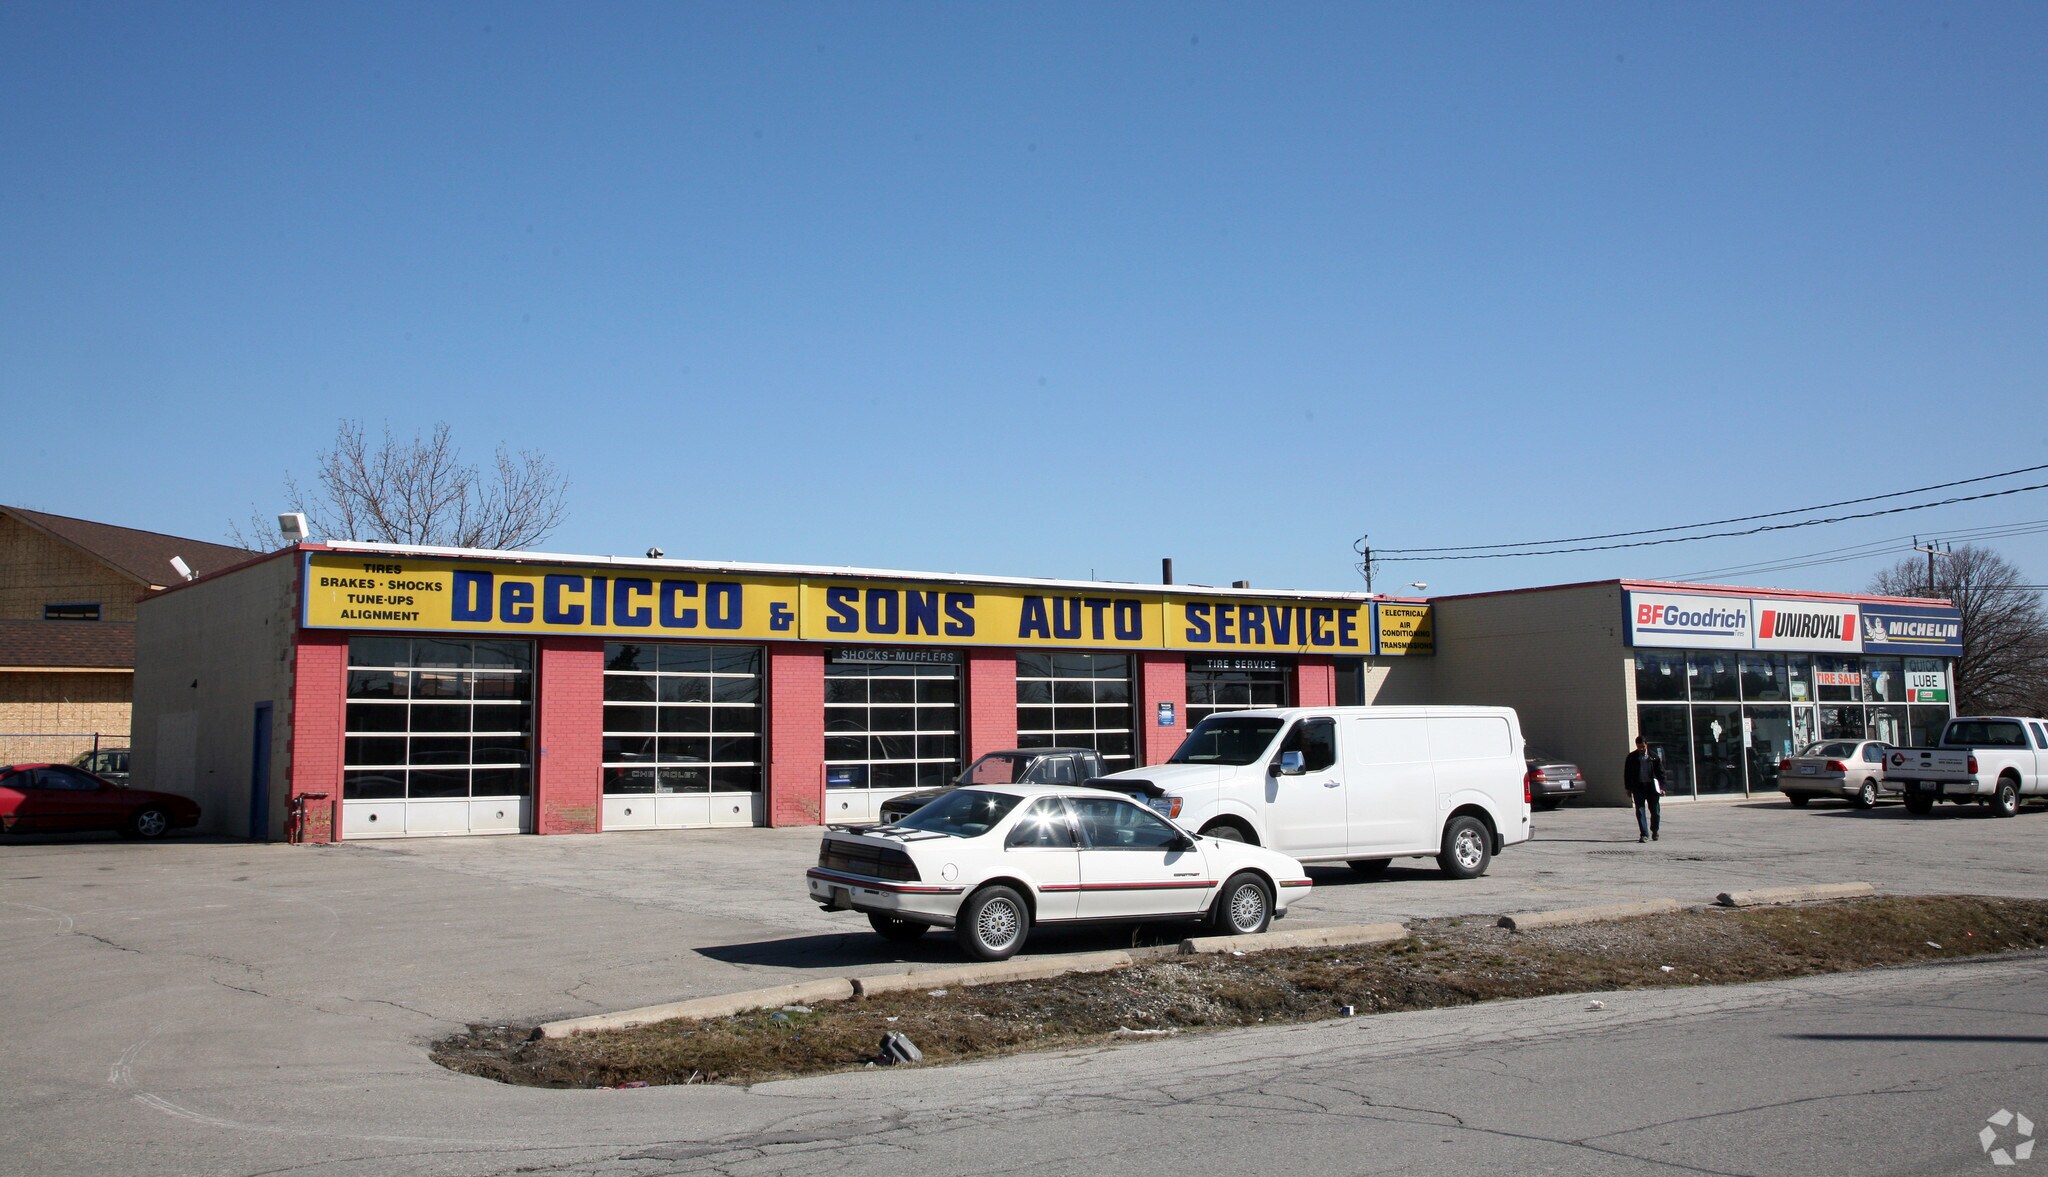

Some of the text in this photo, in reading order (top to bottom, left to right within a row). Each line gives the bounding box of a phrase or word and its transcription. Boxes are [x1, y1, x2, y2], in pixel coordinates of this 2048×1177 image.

[363, 563, 402, 575] TIRES
[320, 577, 443, 592] BRAKES SHOCKS
[347, 594, 414, 606] TUNE-UPS
[451, 569, 1359, 647] DeCICCO & SONS AUTO SERVICE
[340, 609, 420, 621] ALIGNMENT
[1637, 604, 1746, 628] BFGoodrich
[1774, 612, 1842, 639] UNIROYAL
[1889, 621, 1958, 638] MICHELIN
[1381, 629, 1430, 637] CONDITIONING
[1380, 641, 1433, 649] TRANSMISSIONS
[841, 650, 954, 662] SHOCKS-MUFFLERS
[1207, 659, 1276, 669] TIRE SERVICE
[1909, 660, 1938, 672] QUICK
[1816, 673, 1860, 685] TIRE SALE
[1913, 675, 1938, 687] LUBE
